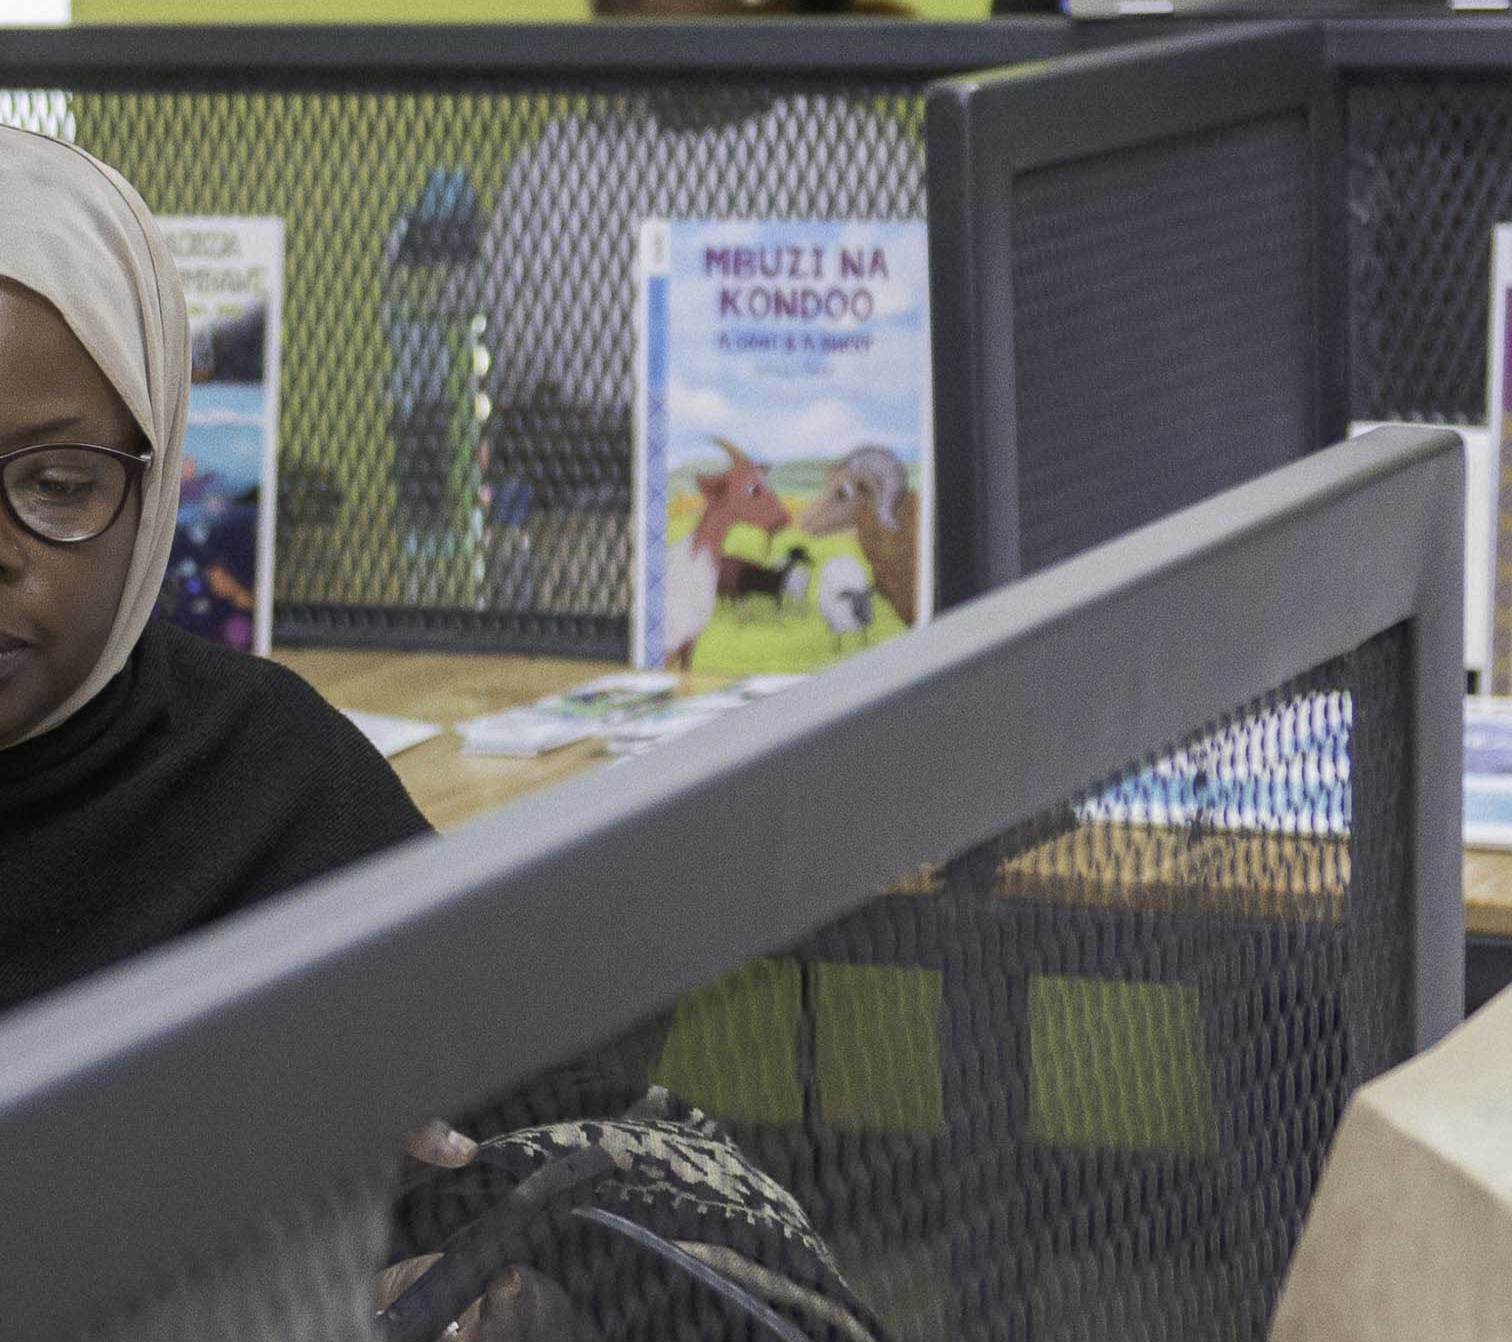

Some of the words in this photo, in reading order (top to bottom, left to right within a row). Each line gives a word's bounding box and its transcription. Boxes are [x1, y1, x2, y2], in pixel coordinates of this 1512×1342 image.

[704, 245, 825, 279] MBUZI
[841, 246, 890, 280] NA
[719, 285, 875, 322] KONDOO
